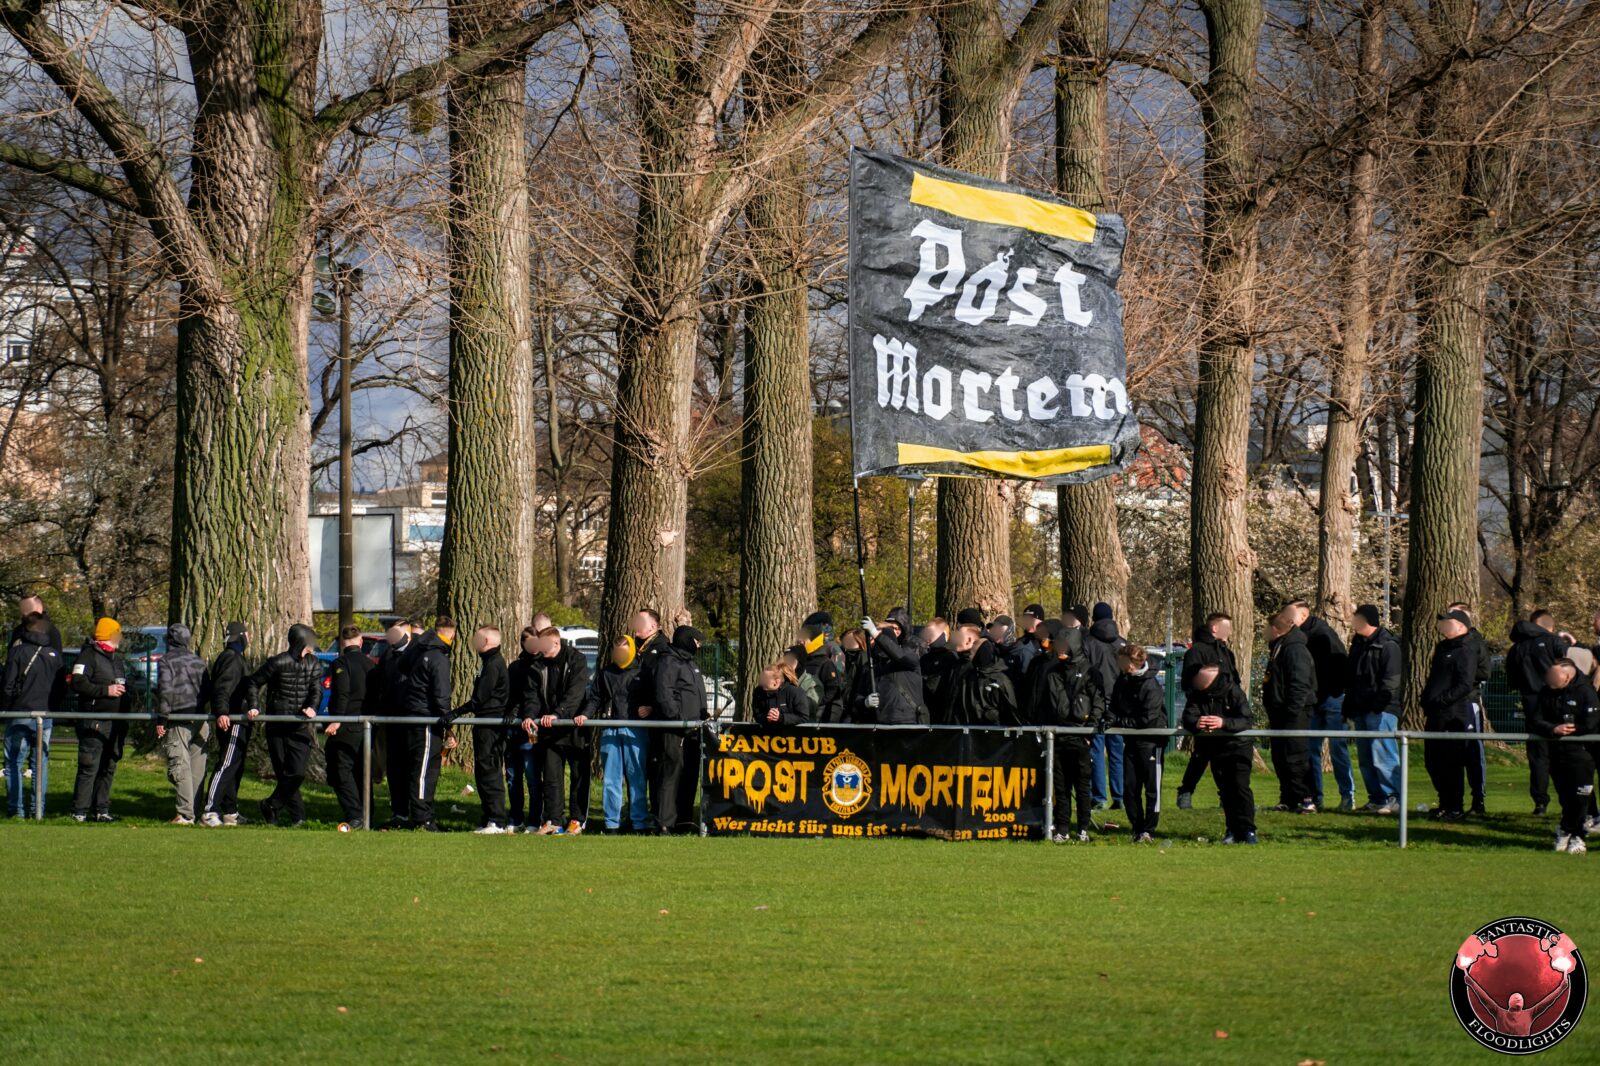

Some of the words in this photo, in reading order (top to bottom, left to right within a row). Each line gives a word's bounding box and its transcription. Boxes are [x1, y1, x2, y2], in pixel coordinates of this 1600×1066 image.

[903, 219, 1093, 327] Post
[873, 333, 1131, 422] Mortem
[718, 734, 837, 755] FANCLUB
[713, 816, 747, 831] Wer
[750, 819, 795, 833] nicht
[799, 820, 827, 835] für
[832, 824, 863, 836] uns
[867, 823, 888, 836] ist
[977, 826, 1008, 839] uns
[1012, 824, 1029, 837] !!!
[984, 812, 1015, 823] 2008
